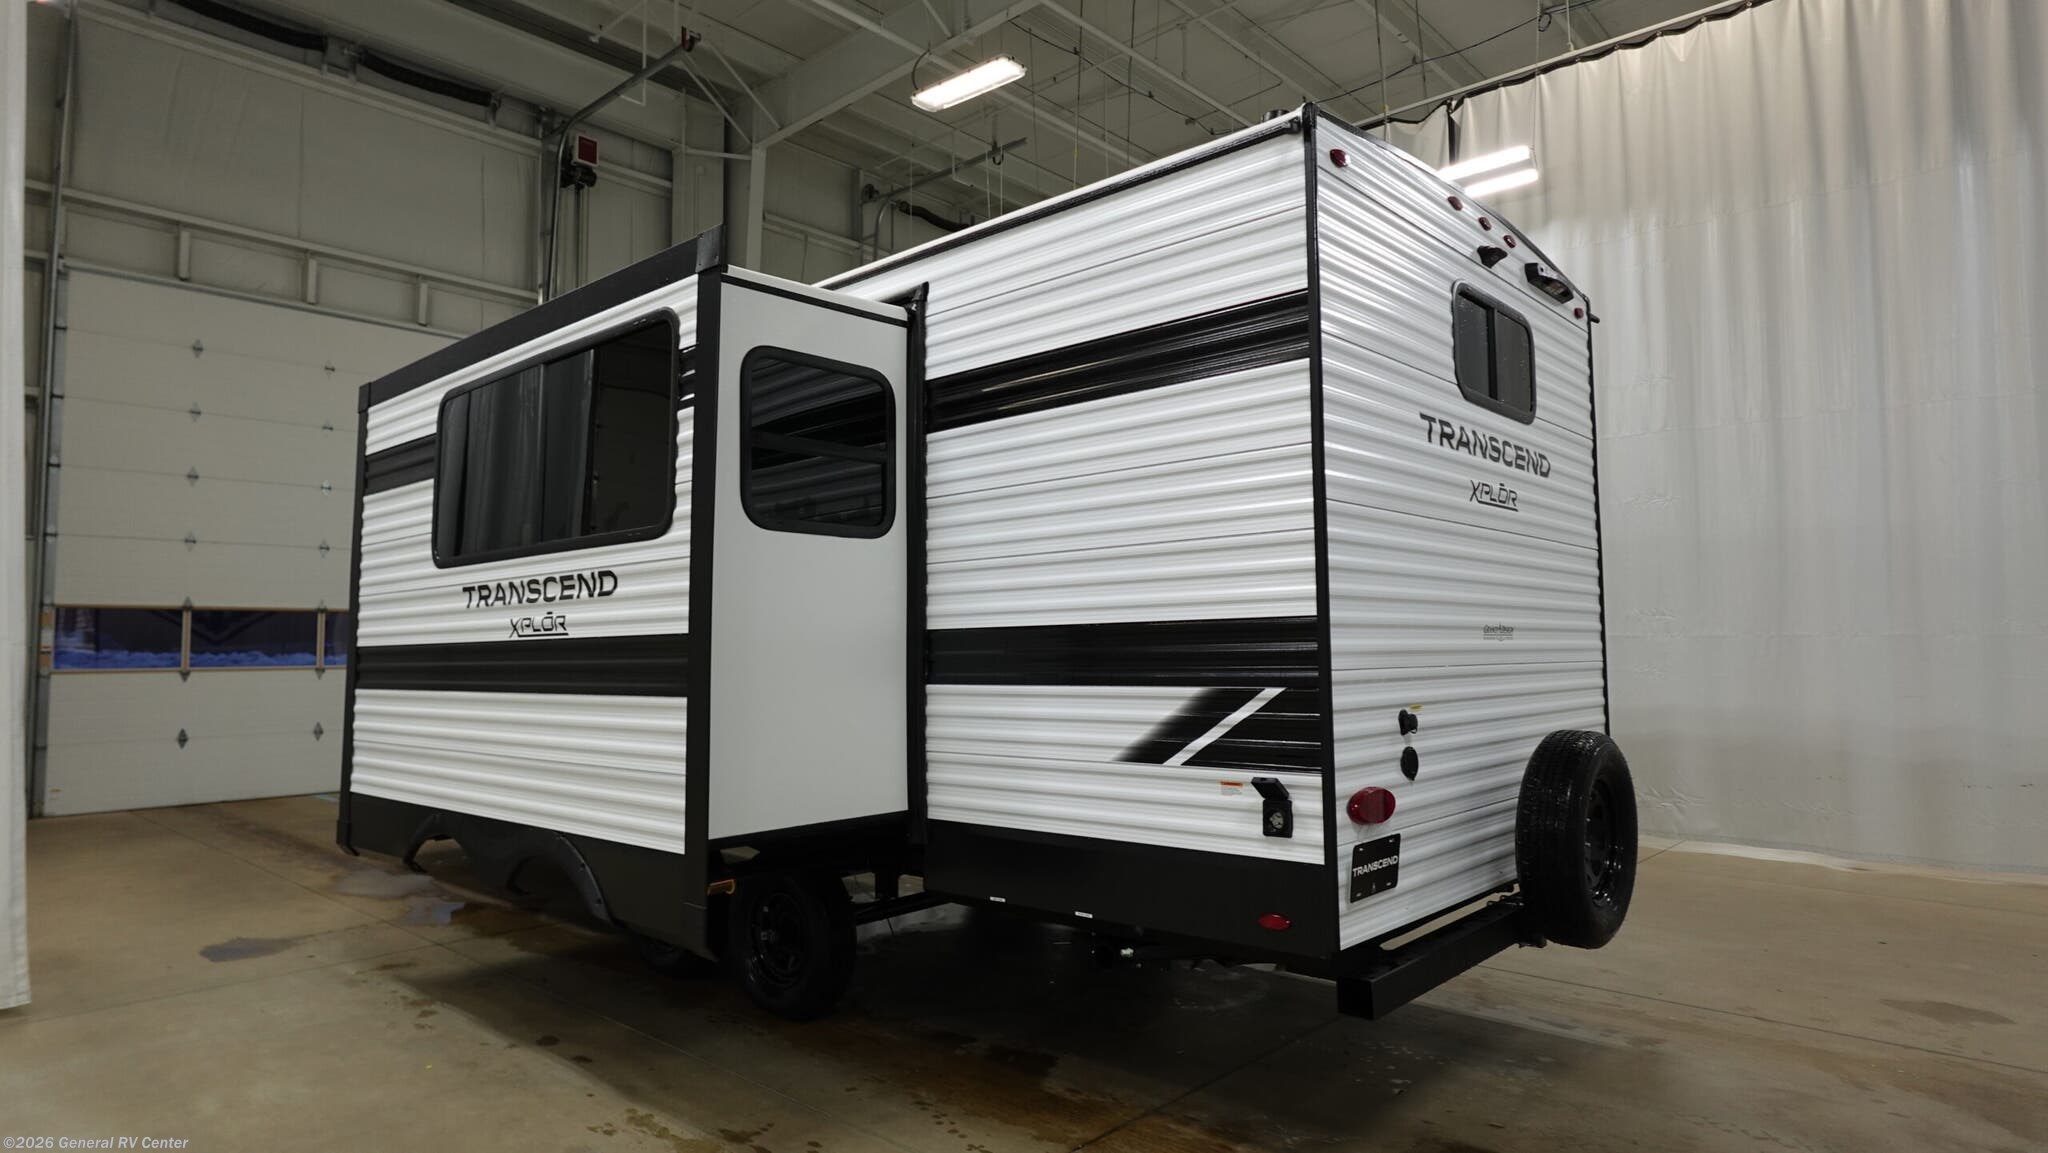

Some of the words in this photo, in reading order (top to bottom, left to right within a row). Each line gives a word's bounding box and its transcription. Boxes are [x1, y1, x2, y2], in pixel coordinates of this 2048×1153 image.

[1419, 411, 1551, 478] TRANSCEND
[462, 569, 618, 609] TRANSCEND
[1352, 855, 1399, 877] TRANSCEND
